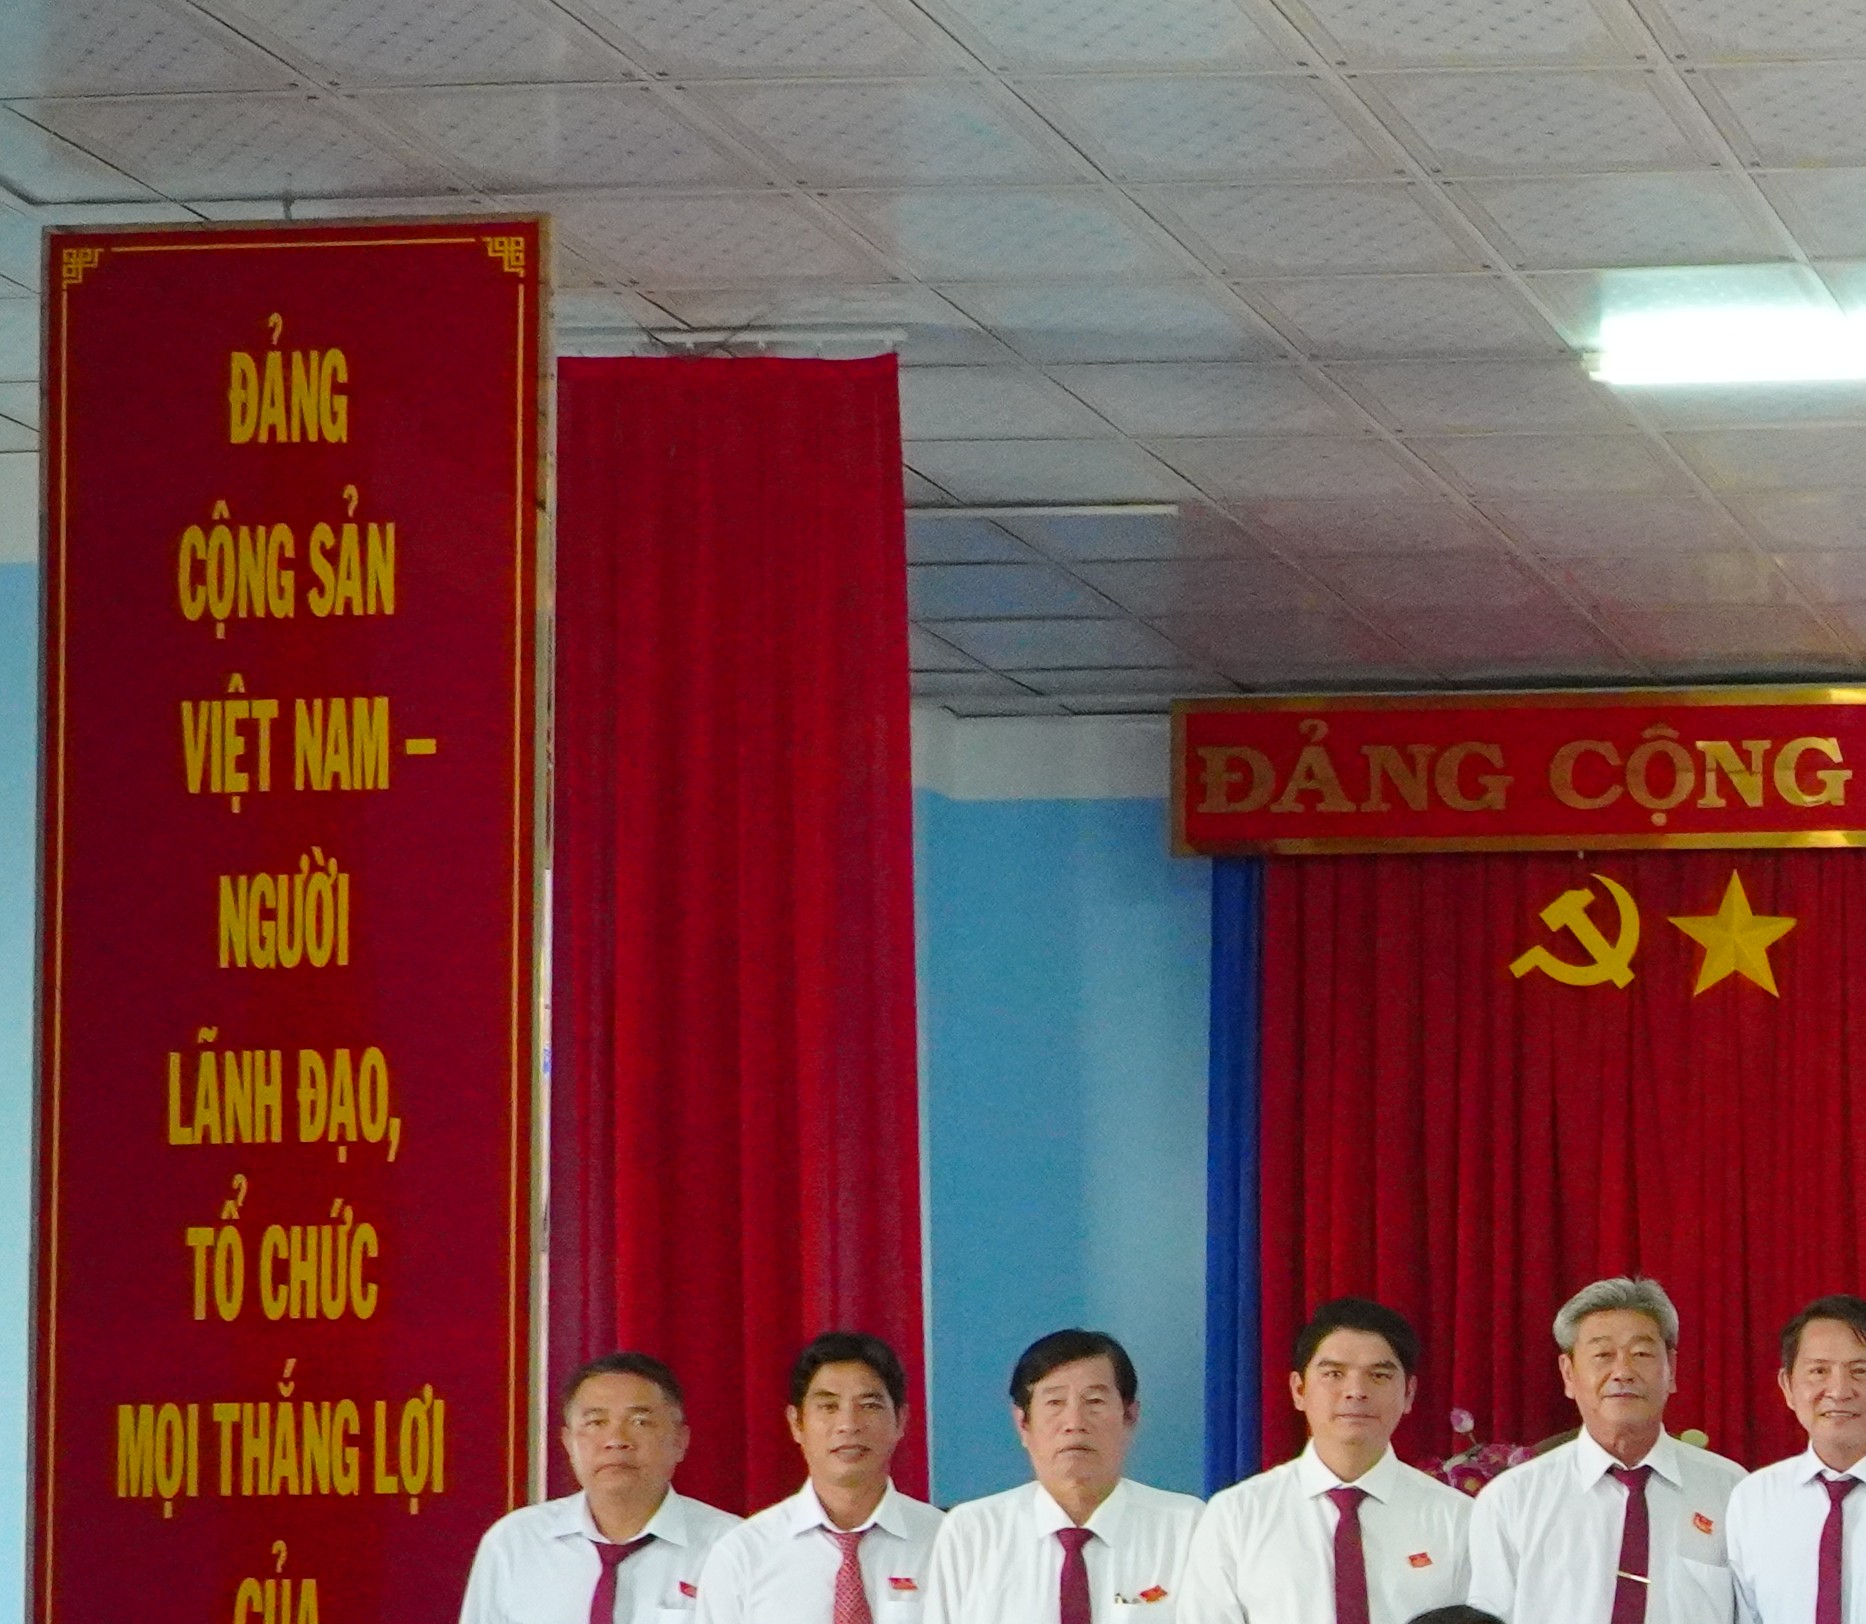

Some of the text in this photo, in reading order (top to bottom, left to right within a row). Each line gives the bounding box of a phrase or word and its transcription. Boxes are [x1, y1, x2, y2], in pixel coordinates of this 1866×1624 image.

[229, 314, 347, 443] ĐẢNG
[179, 486, 394, 635] CỘNG SẢN
[182, 674, 278, 810] VIỆT
[295, 697, 389, 790] NAM
[1197, 719, 1514, 813] ĐẢNG
[1549, 725, 1854, 826] CỘNG
[220, 848, 348, 969] NGƯỜI
[169, 1028, 400, 1160] LÃNH ĐẠO,
[187, 1174, 377, 1321] TỔ CHỨC
[118, 1360, 444, 1516] MỌI THẮNG LỢI
